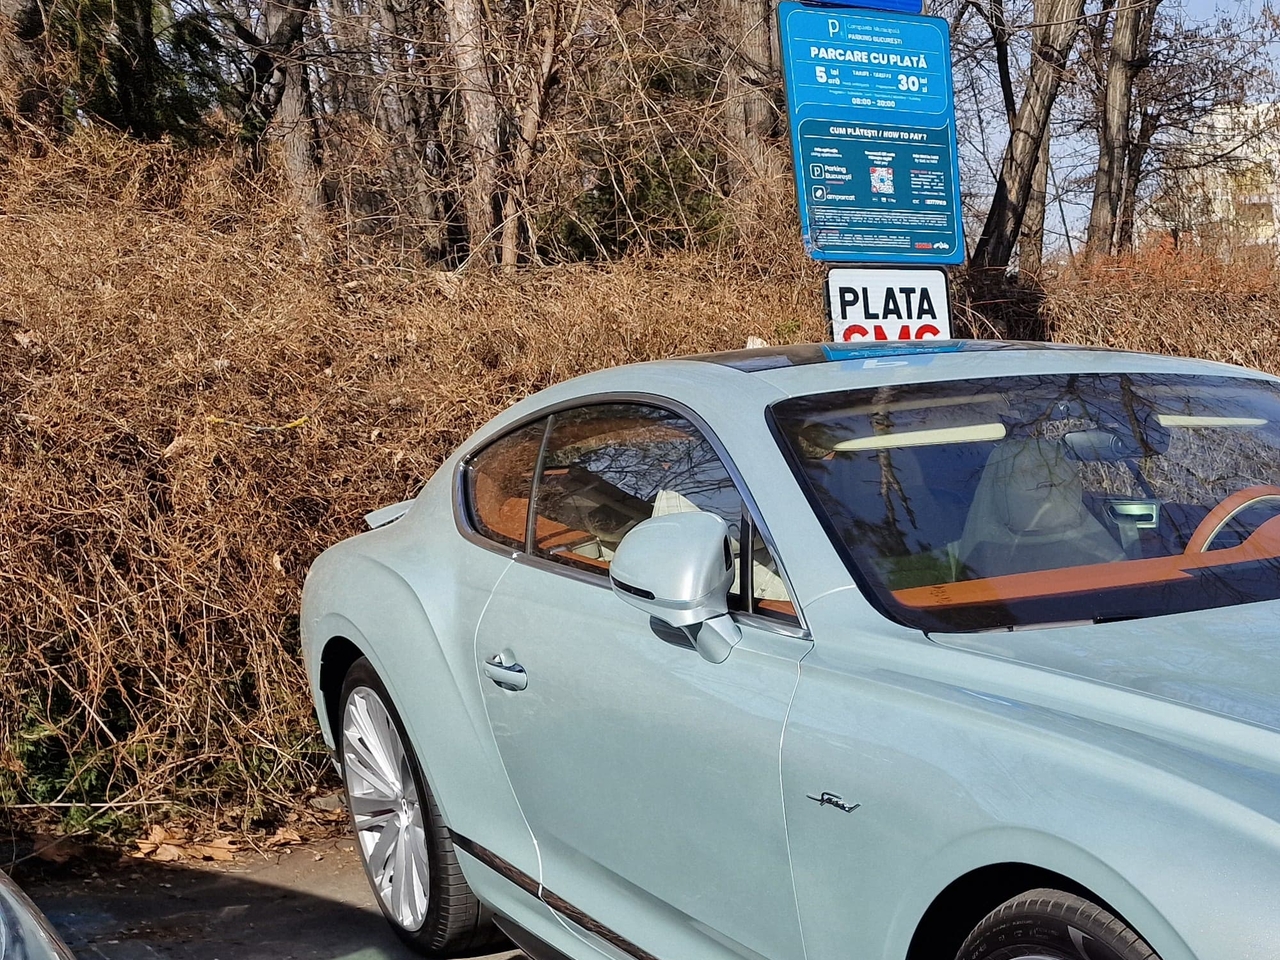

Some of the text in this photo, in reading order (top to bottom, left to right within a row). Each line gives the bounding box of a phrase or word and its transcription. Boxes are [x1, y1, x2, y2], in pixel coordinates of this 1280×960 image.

[810, 46, 928, 69] PARCARE CU PLATĂ
[815, 66, 828, 83] 5
[897, 74, 919, 92] 30
[829, 126, 846, 135] CUM
[883, 131, 899, 139] HOW
[900, 132, 909, 140] TO
[824, 164, 847, 174] Parking
[838, 286, 938, 320] PLATA
